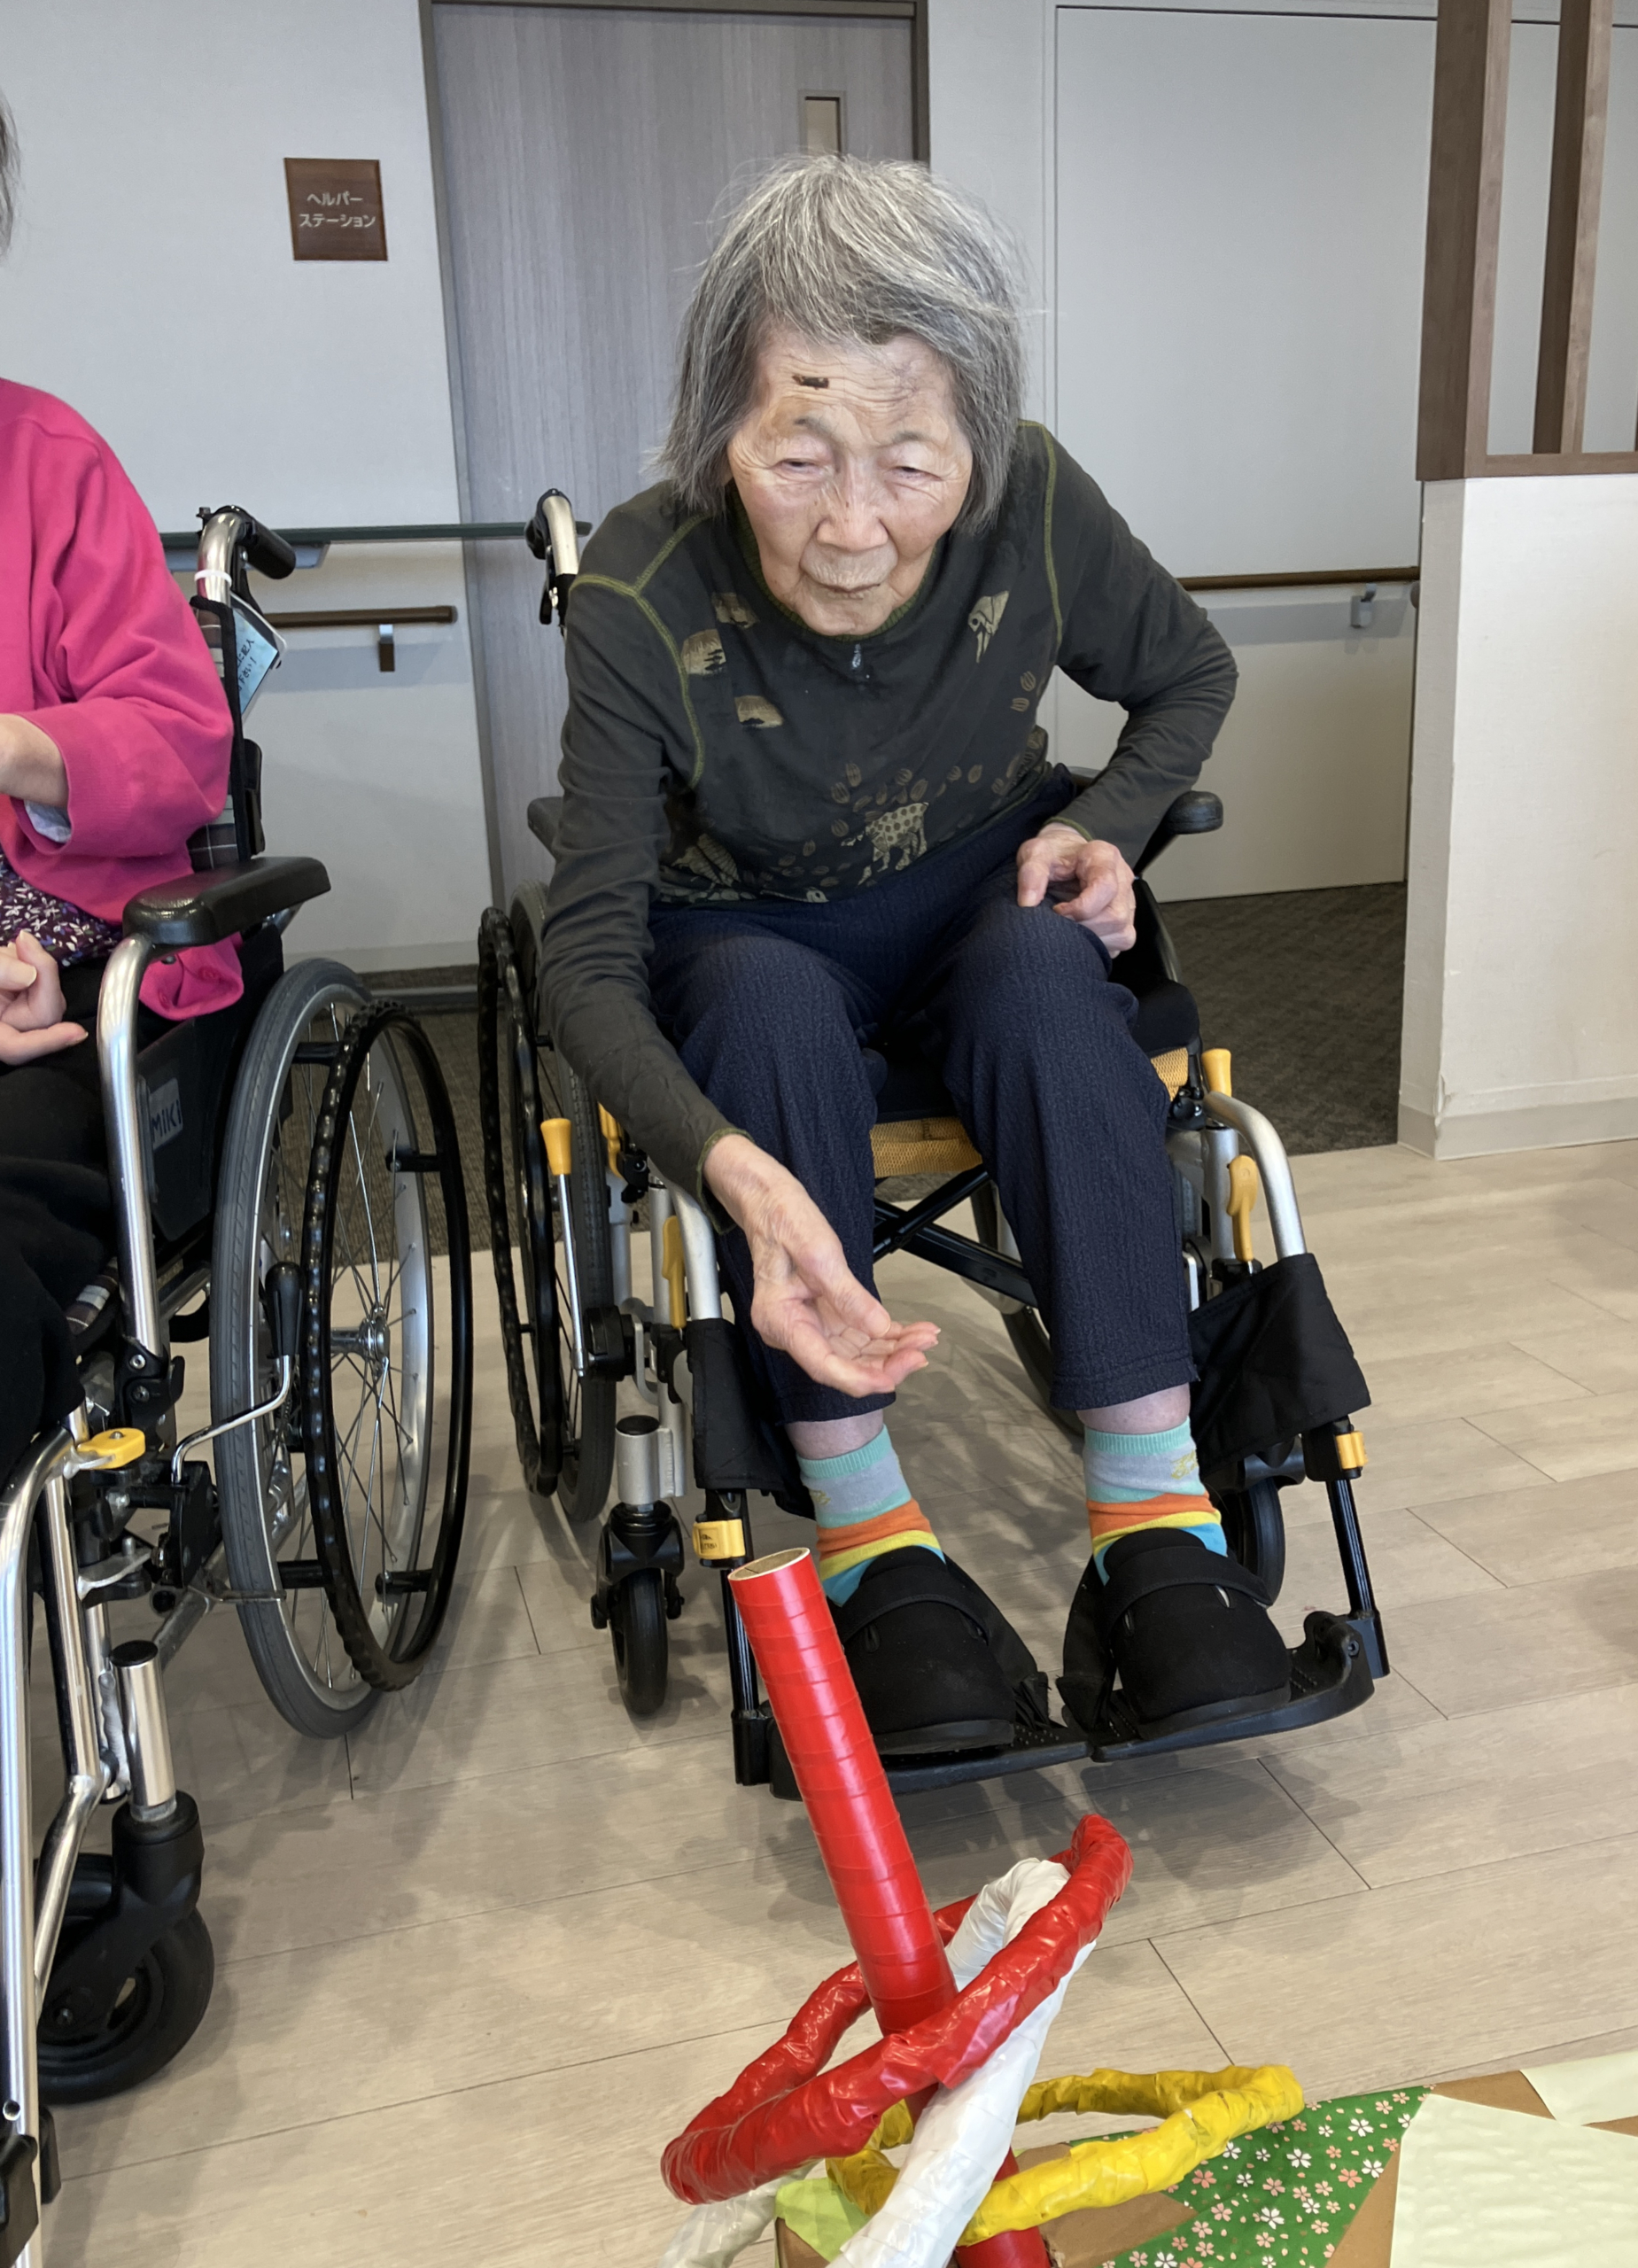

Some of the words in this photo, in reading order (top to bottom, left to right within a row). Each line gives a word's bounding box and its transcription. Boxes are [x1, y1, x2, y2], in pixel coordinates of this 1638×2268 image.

[307, 191, 363, 206] ヘルパー
[299, 214, 376, 228] ステーション
[151, 1099, 182, 1142] MIKI
